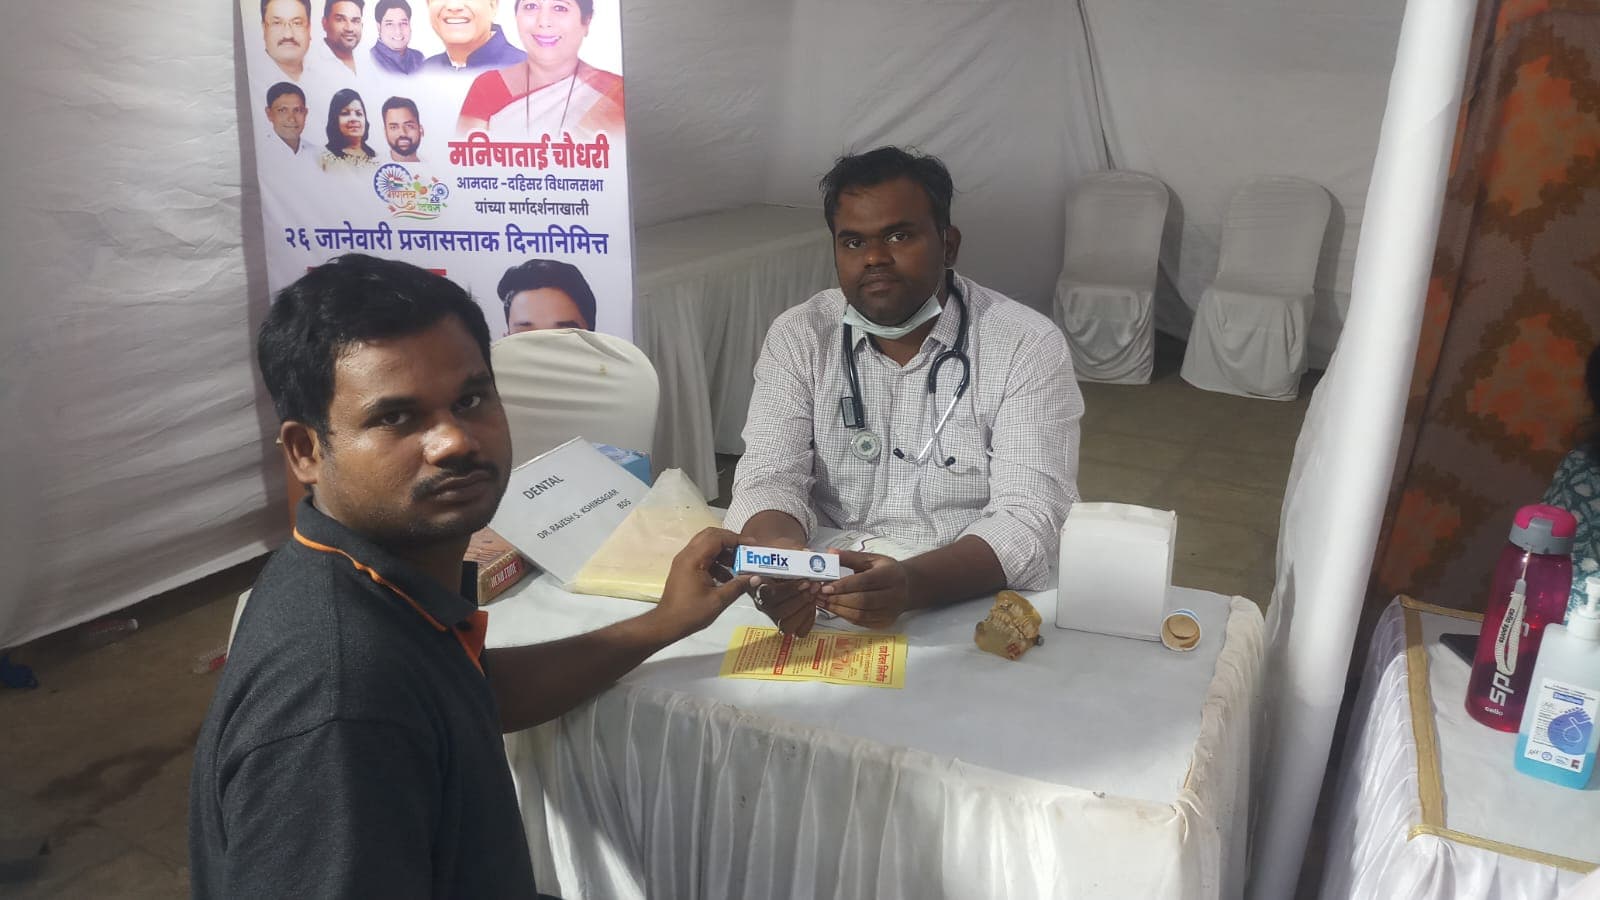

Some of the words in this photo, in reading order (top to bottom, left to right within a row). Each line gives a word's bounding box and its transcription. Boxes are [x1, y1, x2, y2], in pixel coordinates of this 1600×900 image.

[448, 131, 550, 171] मनिषाताई
[551, 131, 609, 169] चौधरी
[457, 176, 498, 190] आमदार
[544, 174, 604, 192] विधानसभा
[474, 198, 506, 214] यांच्या
[509, 197, 589, 216] मार्गदर्शनाखाली
[285, 227, 310, 251] २६
[314, 221, 393, 250] जानेवारी
[398, 229, 500, 252] प्रजासत्ताक
[505, 223, 609, 254] दिनानिमित्त
[522, 474, 565, 500] DENTAL
[536, 529, 552, 540] DR.
[550, 515, 577, 533] RAJESH
[580, 488, 620, 514] KSHIRSAGAR
[616, 498, 632, 510] BDS
[746, 551, 789, 567] EnaFix
